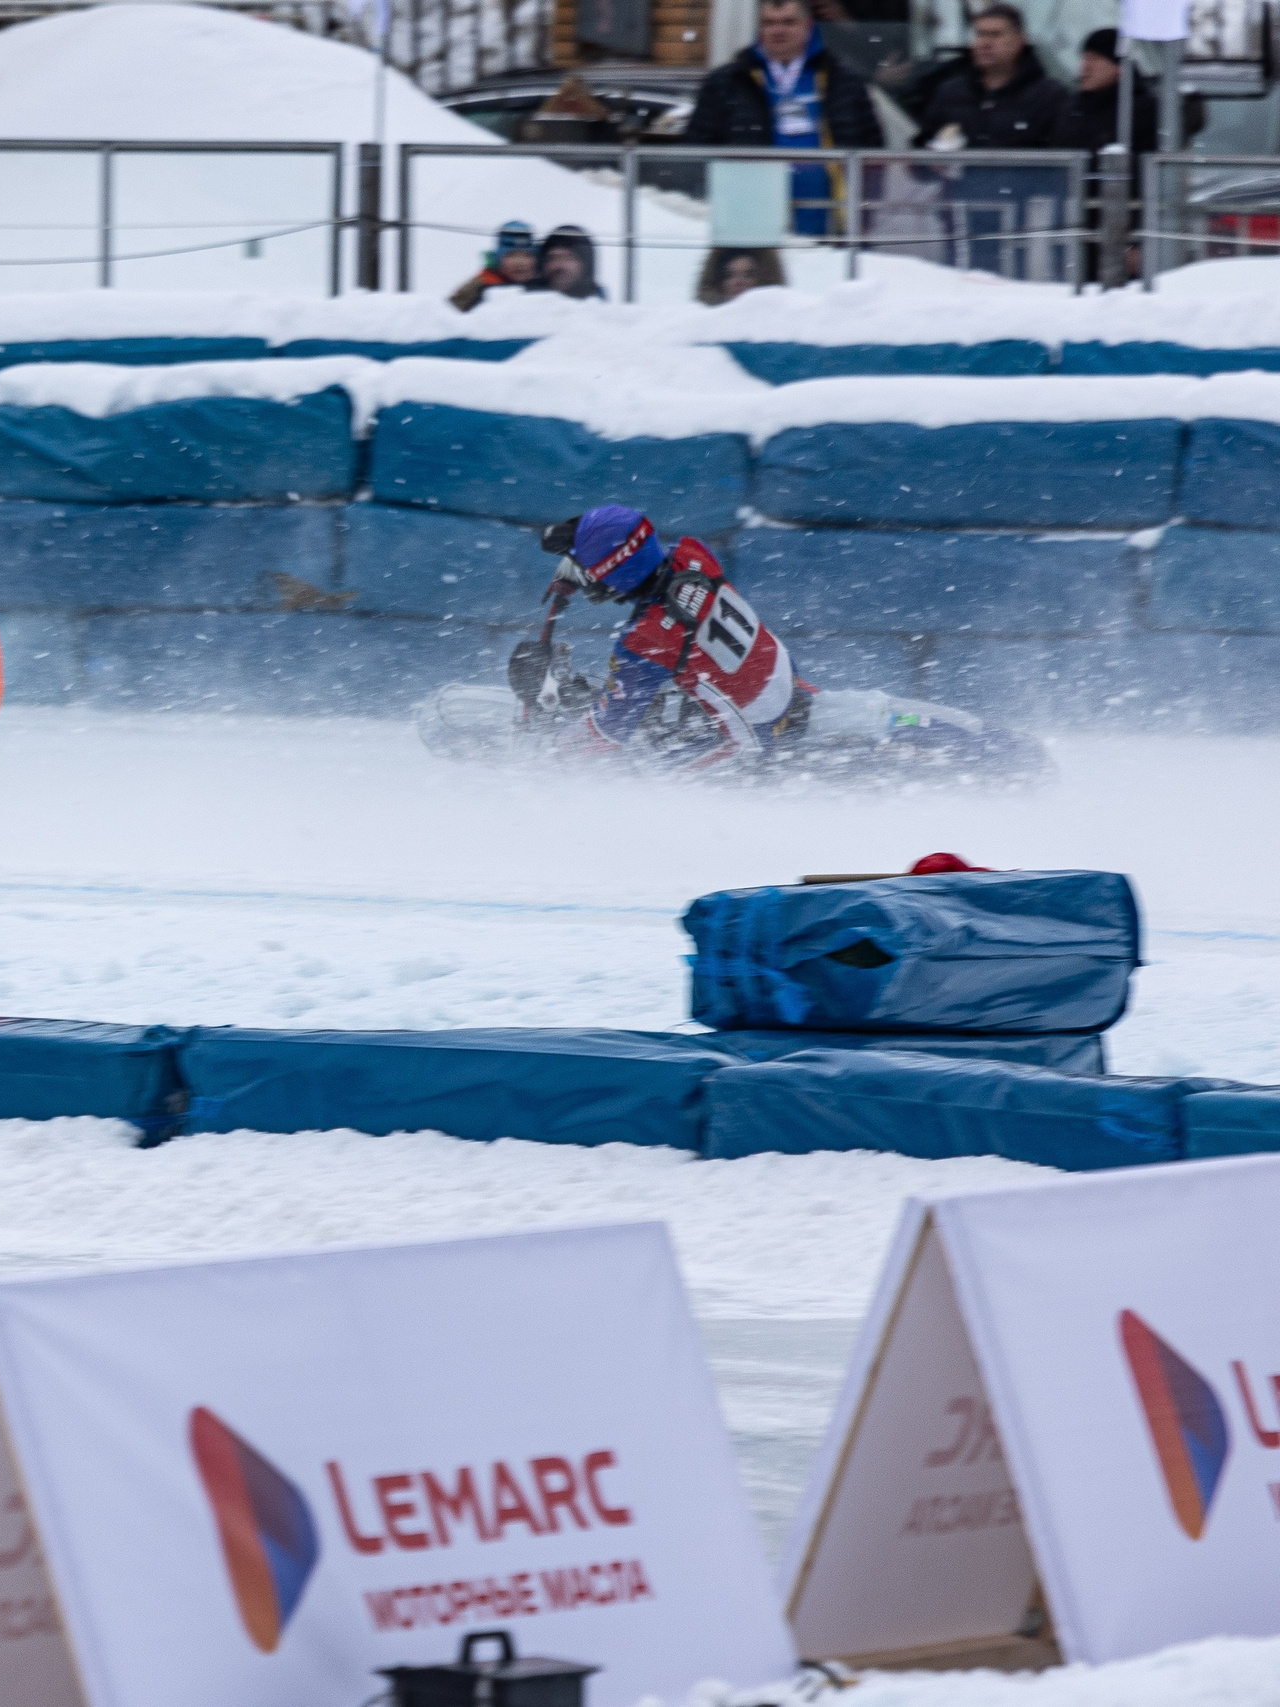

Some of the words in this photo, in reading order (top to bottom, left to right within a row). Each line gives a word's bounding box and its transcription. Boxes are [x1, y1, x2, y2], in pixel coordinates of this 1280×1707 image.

[708, 597, 755, 660] 11
[324, 1450, 632, 1556] LEMARC
[539, 1559, 655, 1611] МАСЛА
